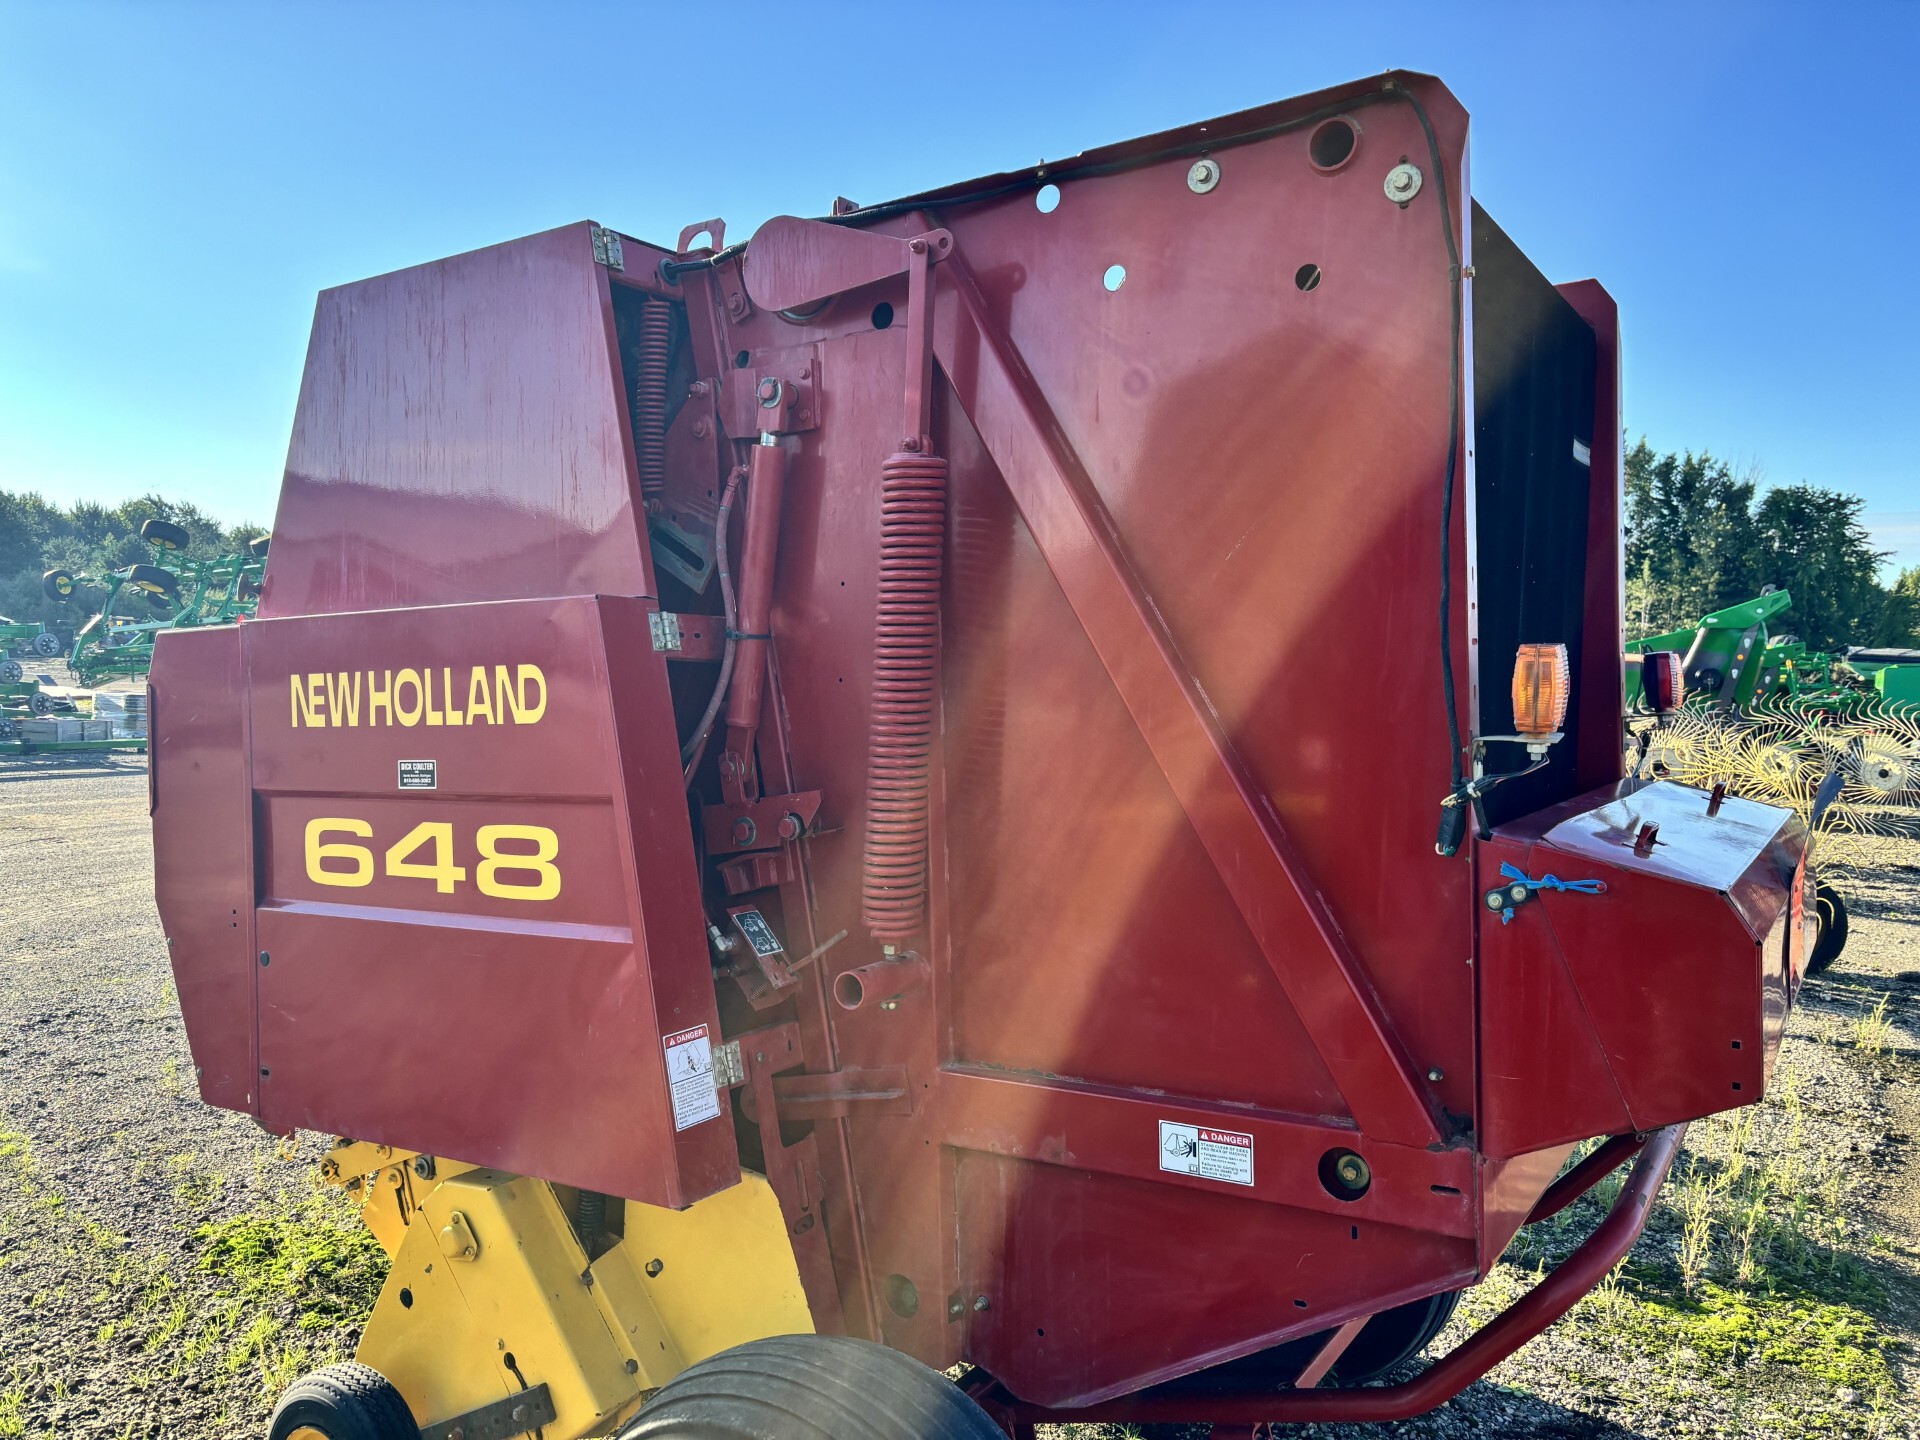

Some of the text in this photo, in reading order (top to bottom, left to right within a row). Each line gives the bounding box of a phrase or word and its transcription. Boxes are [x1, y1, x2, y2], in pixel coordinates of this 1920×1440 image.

[291, 664, 546, 727] NEW HOLLAND
[305, 818, 561, 901] 648
[677, 1029, 703, 1043] DANGER
[1211, 1133, 1249, 1145] DANGER
